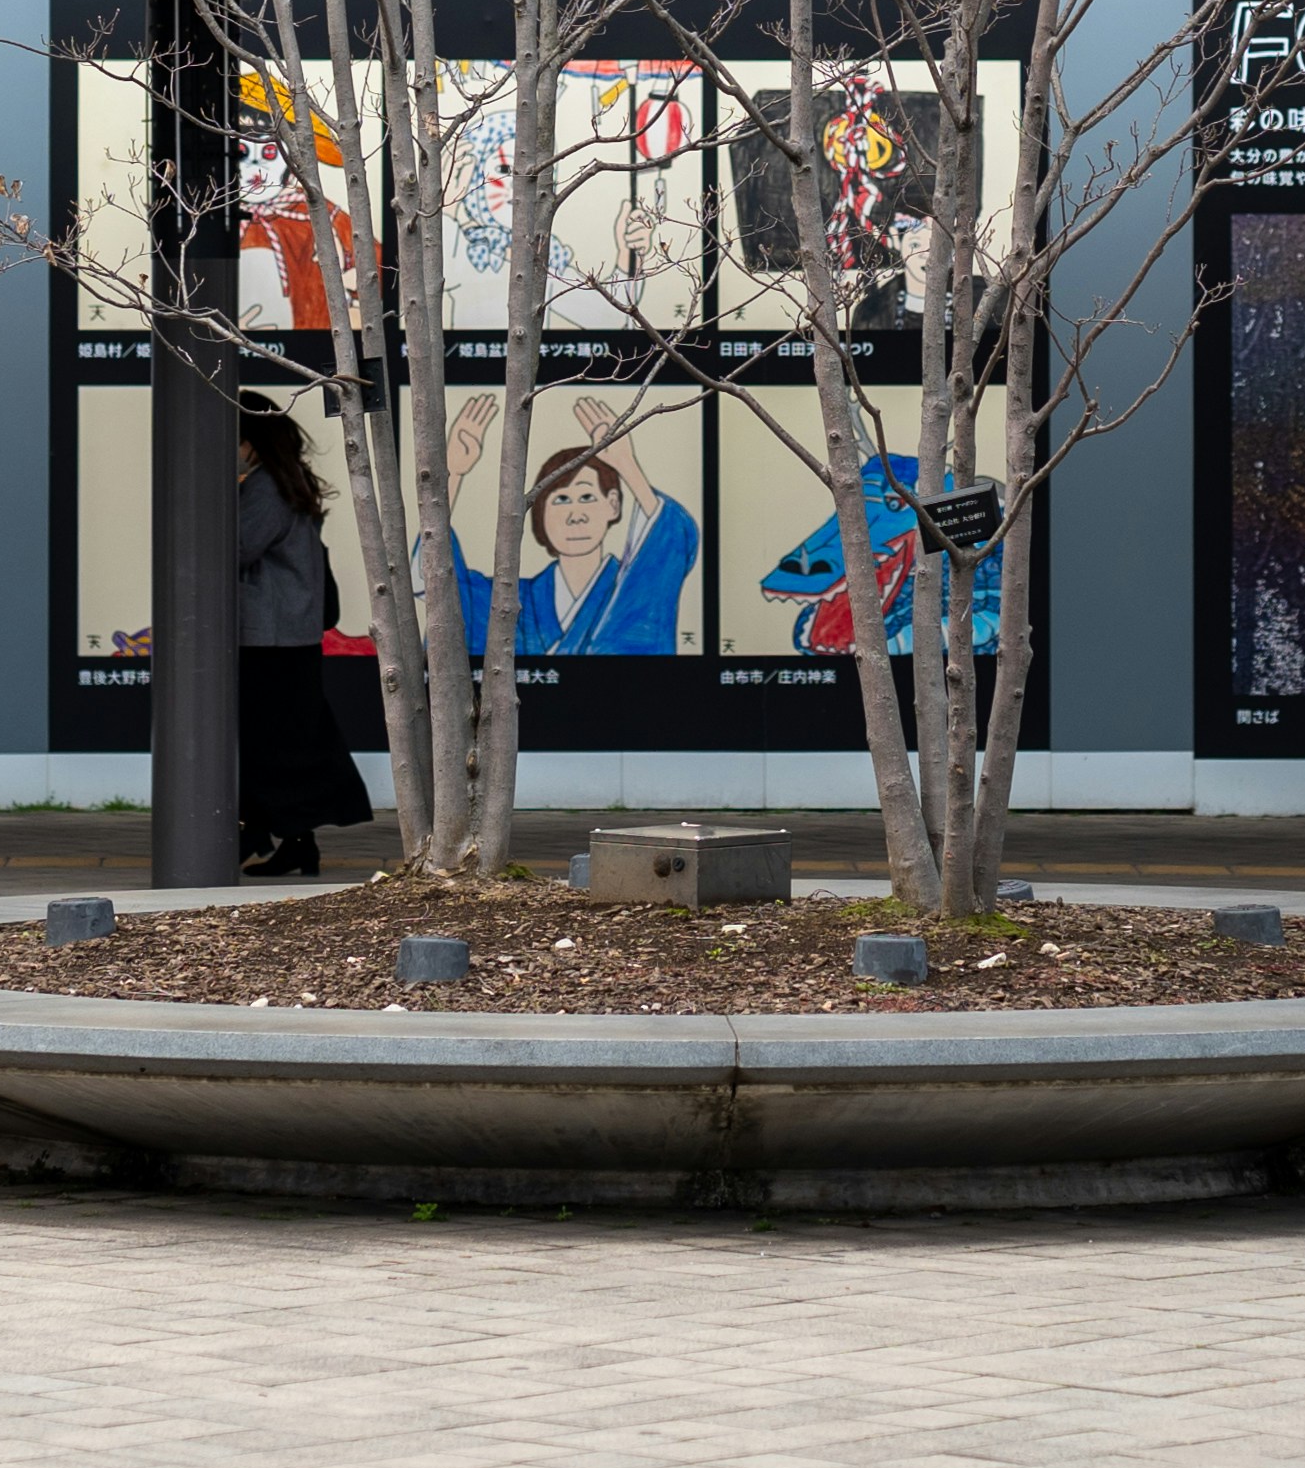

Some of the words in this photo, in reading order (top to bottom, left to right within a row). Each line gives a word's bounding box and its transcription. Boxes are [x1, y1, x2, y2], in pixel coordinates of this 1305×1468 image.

[720, 670, 837, 685] 由布市／庄内神楽
[1237, 709, 1280, 725] 関さば
